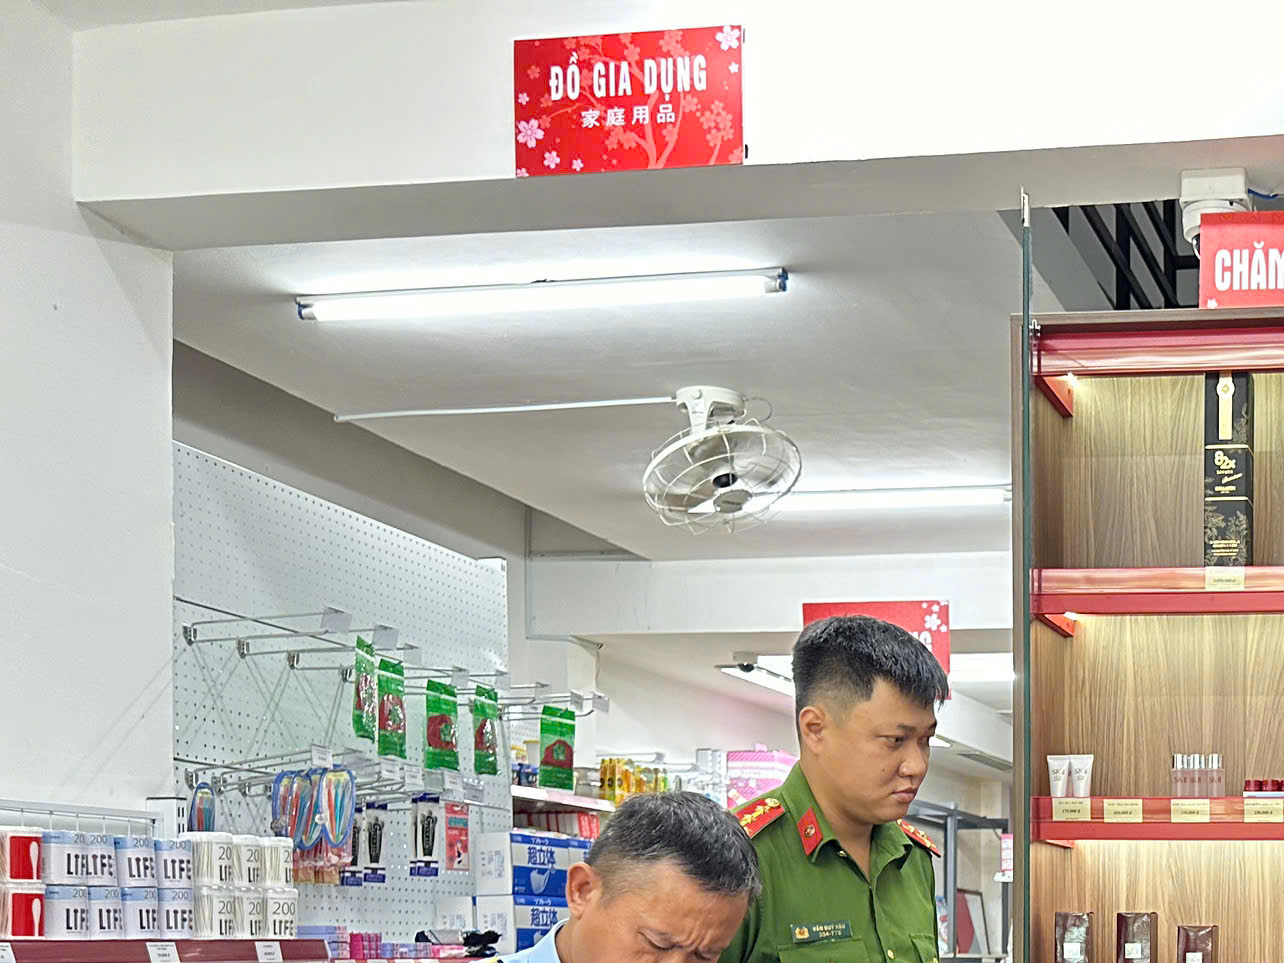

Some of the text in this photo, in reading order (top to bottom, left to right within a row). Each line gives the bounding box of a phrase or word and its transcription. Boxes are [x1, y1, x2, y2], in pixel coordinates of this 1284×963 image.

[549, 51, 708, 101] ĐỒ GIA DỤNG
[581, 105, 675, 128] 家庭用品
